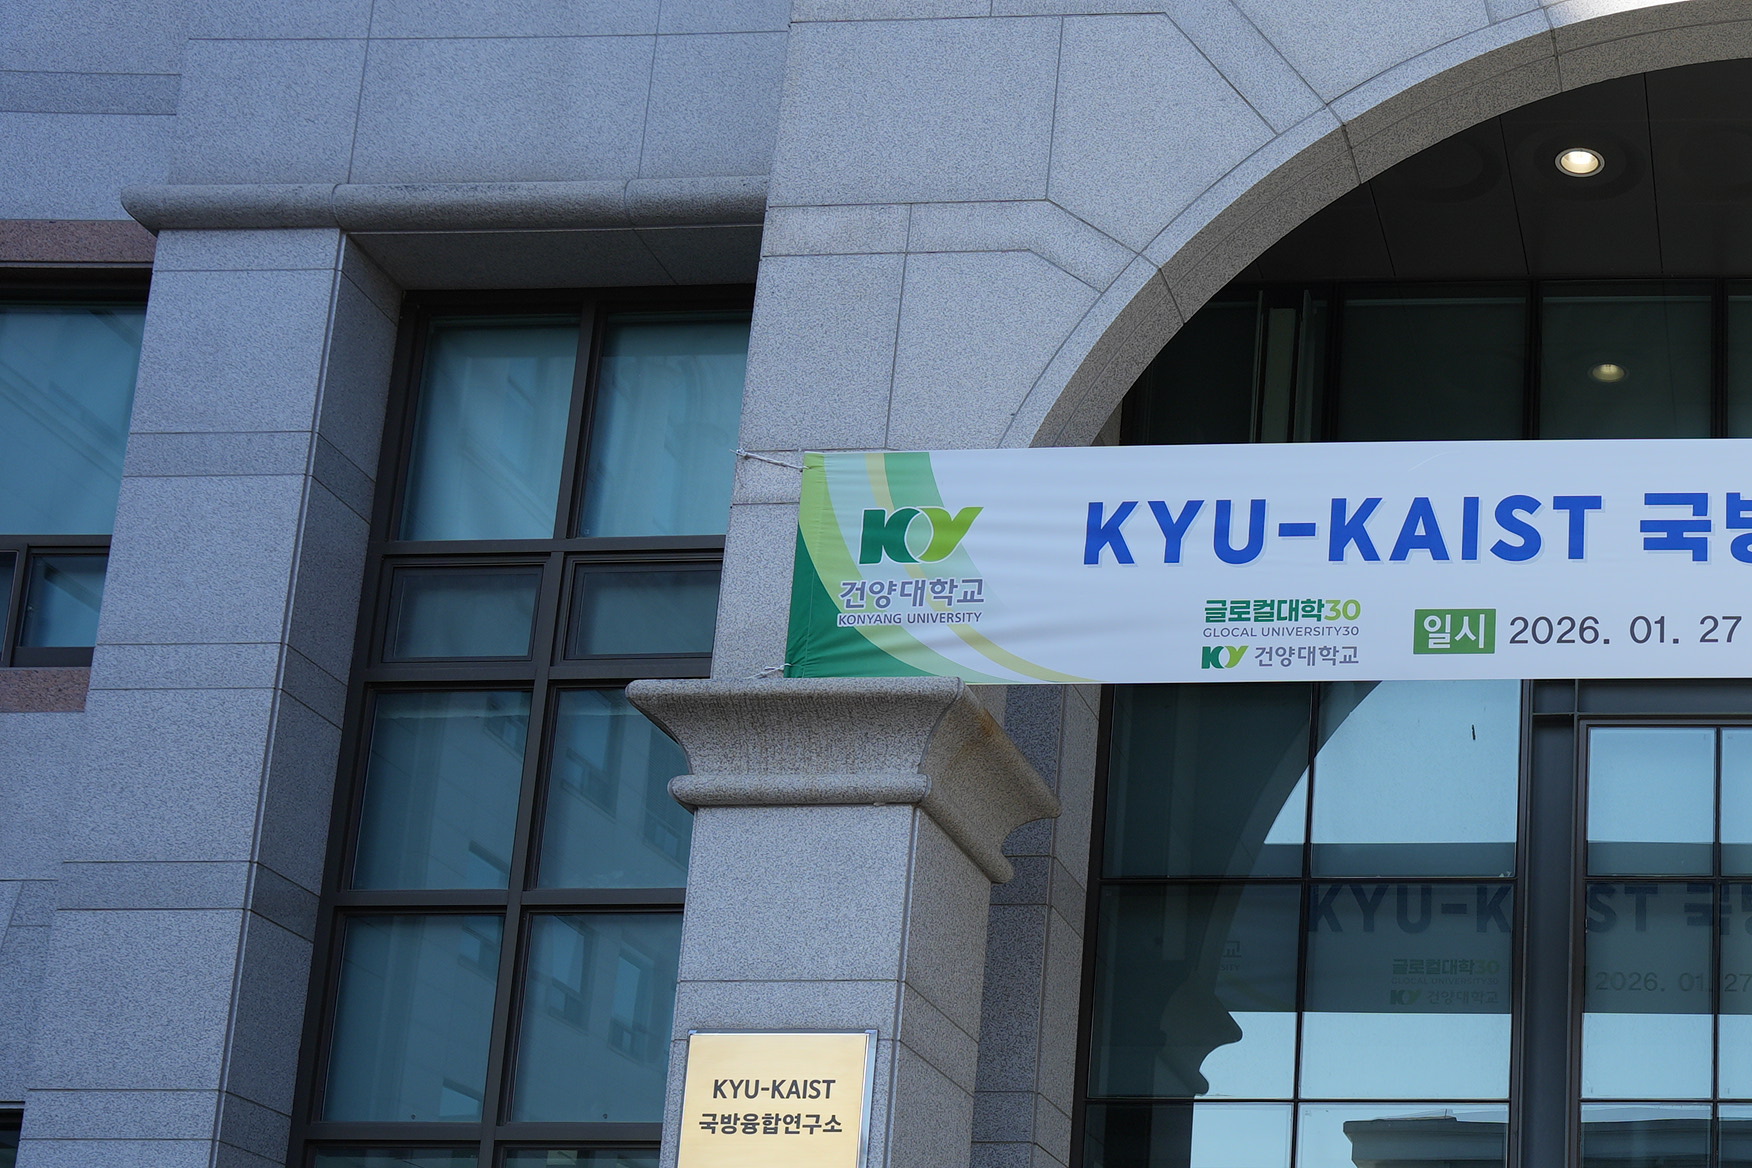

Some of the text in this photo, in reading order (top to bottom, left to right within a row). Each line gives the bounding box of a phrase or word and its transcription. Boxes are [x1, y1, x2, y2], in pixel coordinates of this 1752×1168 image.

[858, 506, 984, 565] KY
[1083, 494, 1603, 567] KYU-KAIST
[838, 578, 985, 609] 건양대학교
[838, 611, 982, 626] KONYANG UNIVERSITY
[1204, 598, 1362, 623] 글로컬대학30
[1203, 625, 1360, 638] GLOCAL UNIVERSITY30
[1423, 613, 1486, 649] 일시
[1509, 616, 1610, 645] 2026.
[1629, 615, 1680, 644] 01.
[1699, 615, 1742, 643] 27
[1201, 645, 1359, 669] KY 건양대학교
[1392, 958, 1500, 975] 글로컬대학30
[1724, 971, 1752, 993] 27
[1427, 989, 1499, 1005] 건양대학교
[713, 1079, 836, 1100] KYU-KAIST
[699, 1113, 843, 1135] 국방융합연구소
